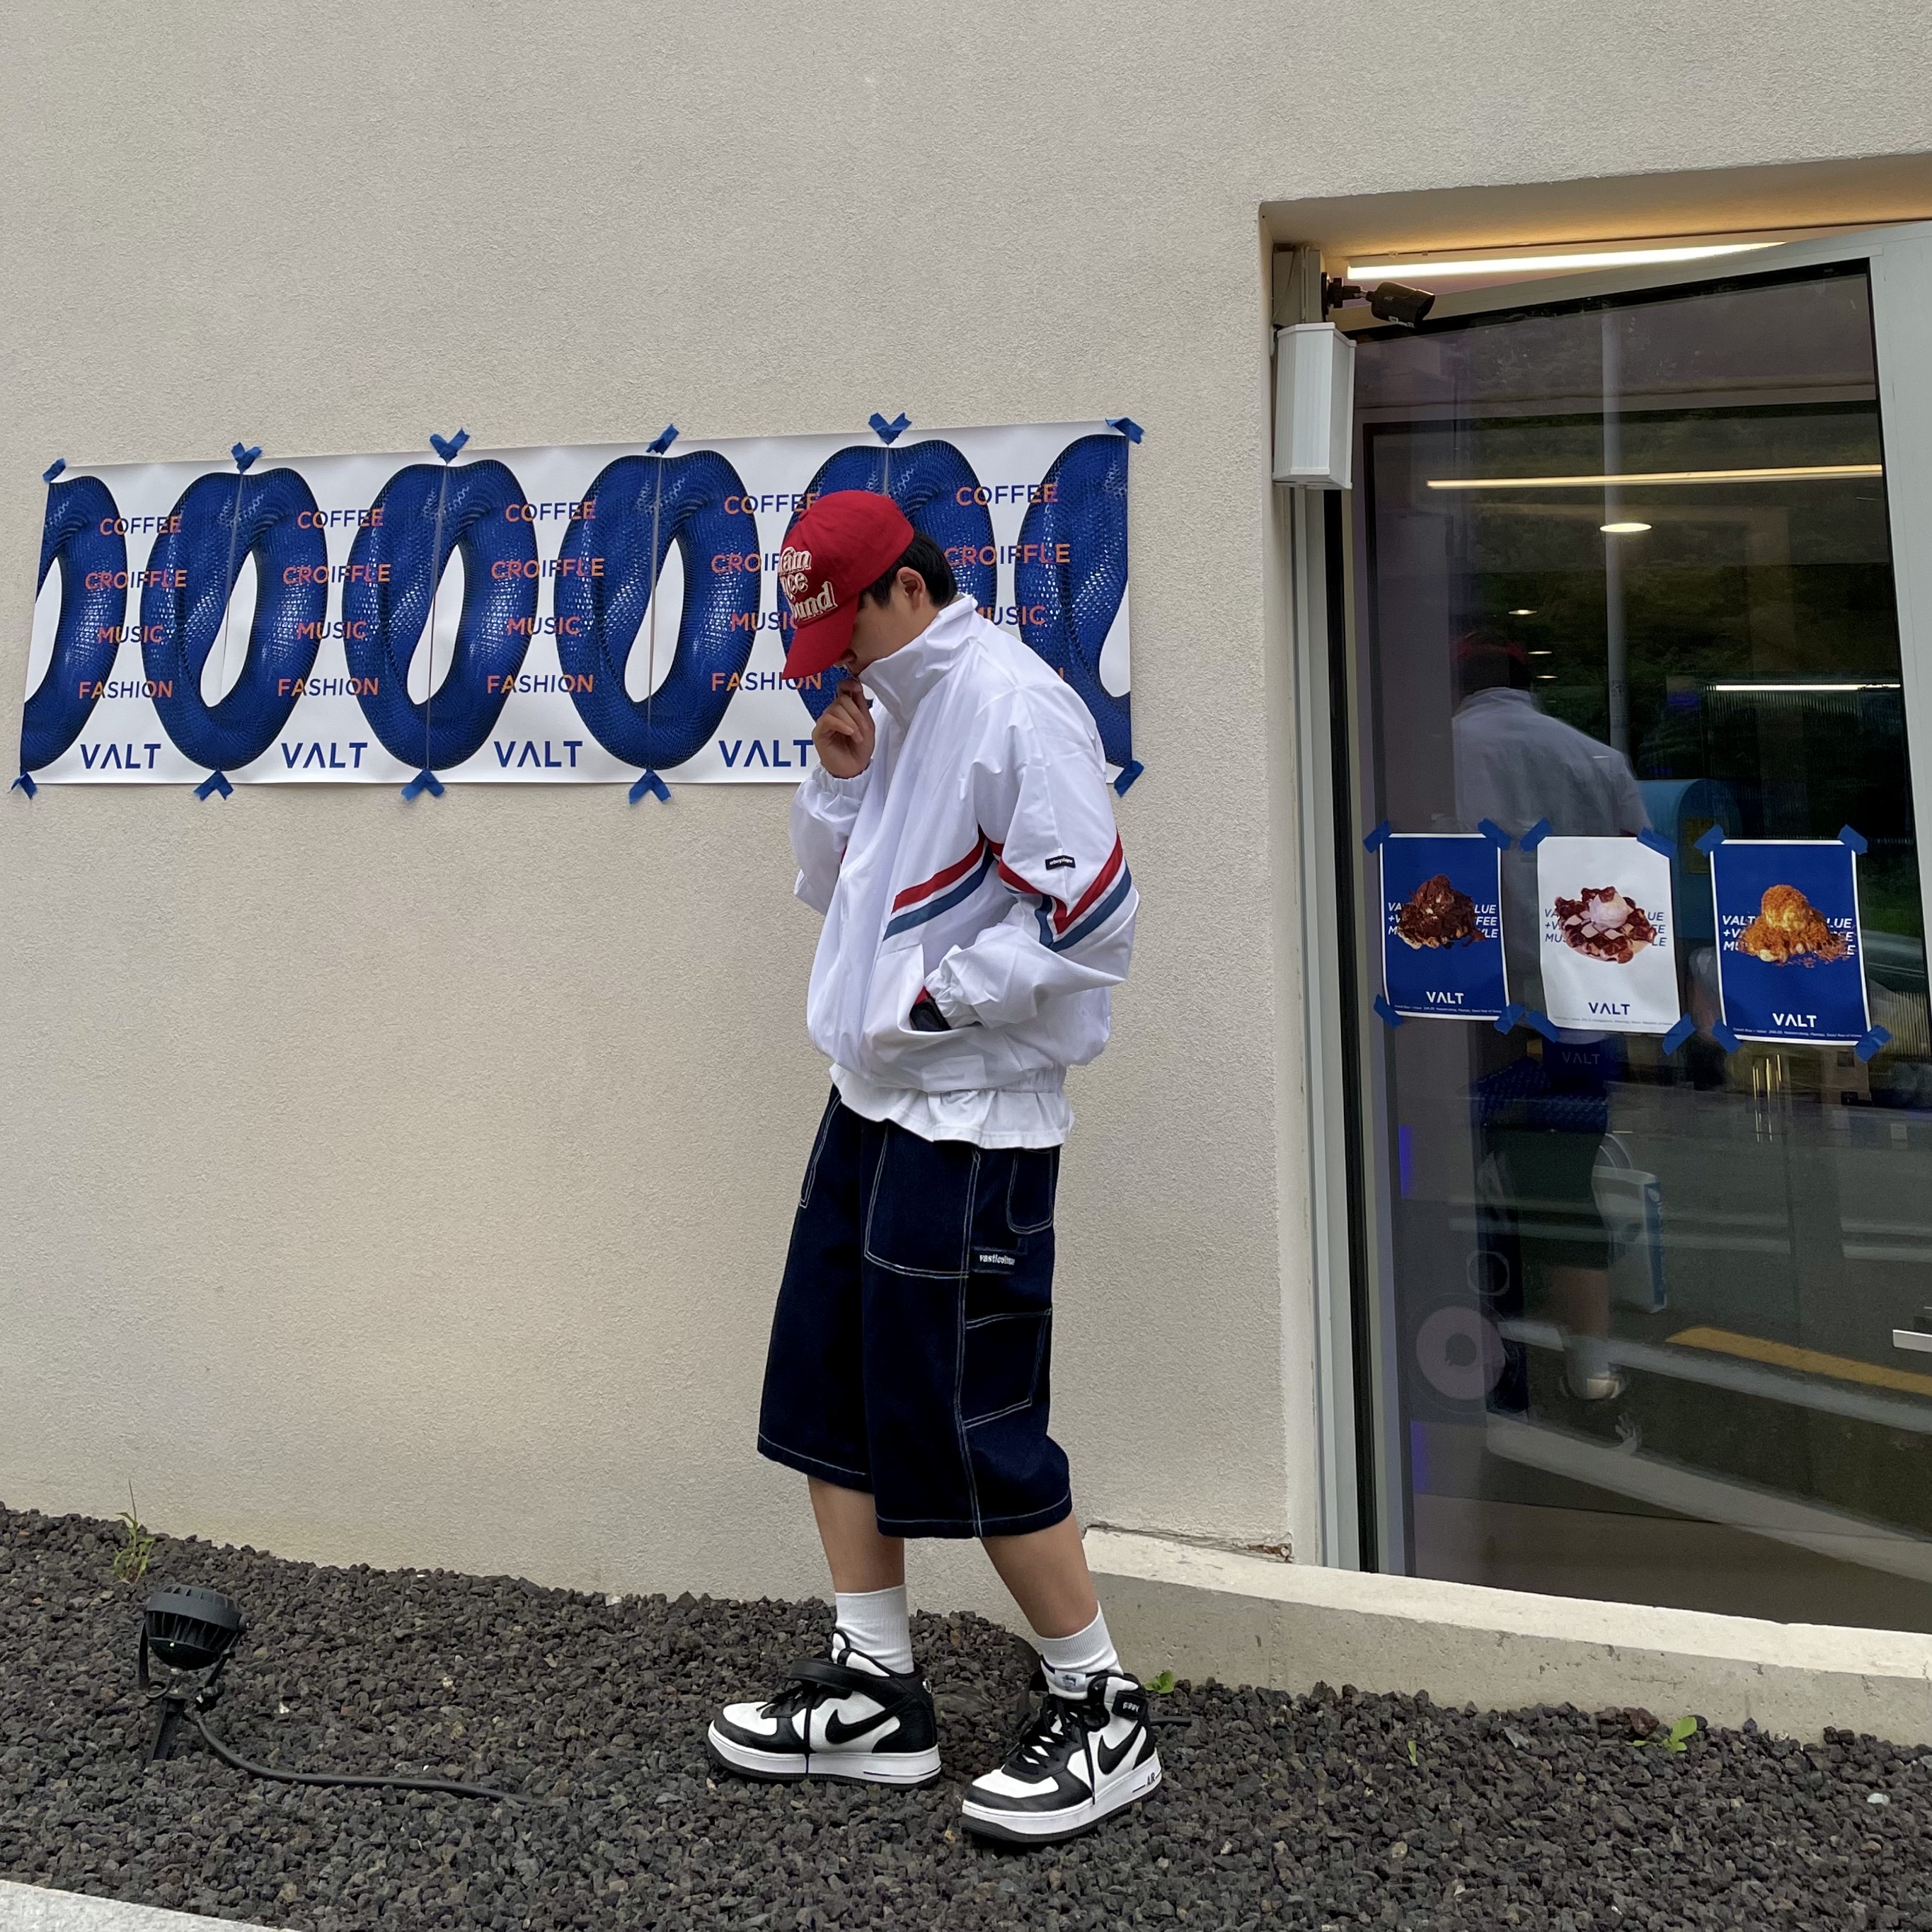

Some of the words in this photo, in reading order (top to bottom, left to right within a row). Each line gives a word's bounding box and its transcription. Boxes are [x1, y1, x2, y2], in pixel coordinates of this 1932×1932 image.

[955, 483, 1059, 506] COFFEE
[297, 508, 384, 529] COFFEE
[505, 500, 597, 523] COFFEE
[99, 515, 182, 536] COFFEE
[490, 557, 605, 579] CROIFFLE
[711, 553, 779, 573] CROIF
[85, 569, 187, 590] CROIFFLE
[282, 564, 391, 585] CROIFFLE
[98, 624, 163, 644] MUSIC
[296, 620, 367, 640] MUSIC
[507, 615, 580, 636] MUSIC
[79, 680, 173, 699] FASHION
[277, 677, 379, 697] FASHION
[487, 673, 594, 694] FASHION
[711, 671, 822, 691] FASHION
[80, 743, 161, 769] VALT
[282, 742, 367, 769] VALT
[493, 740, 583, 768] VALT
[718, 740, 814, 768] VALT
[1426, 991, 1464, 1004] VALT
[1588, 1002, 1630, 1015] VALT
[1772, 1013, 1817, 1028] VALT
